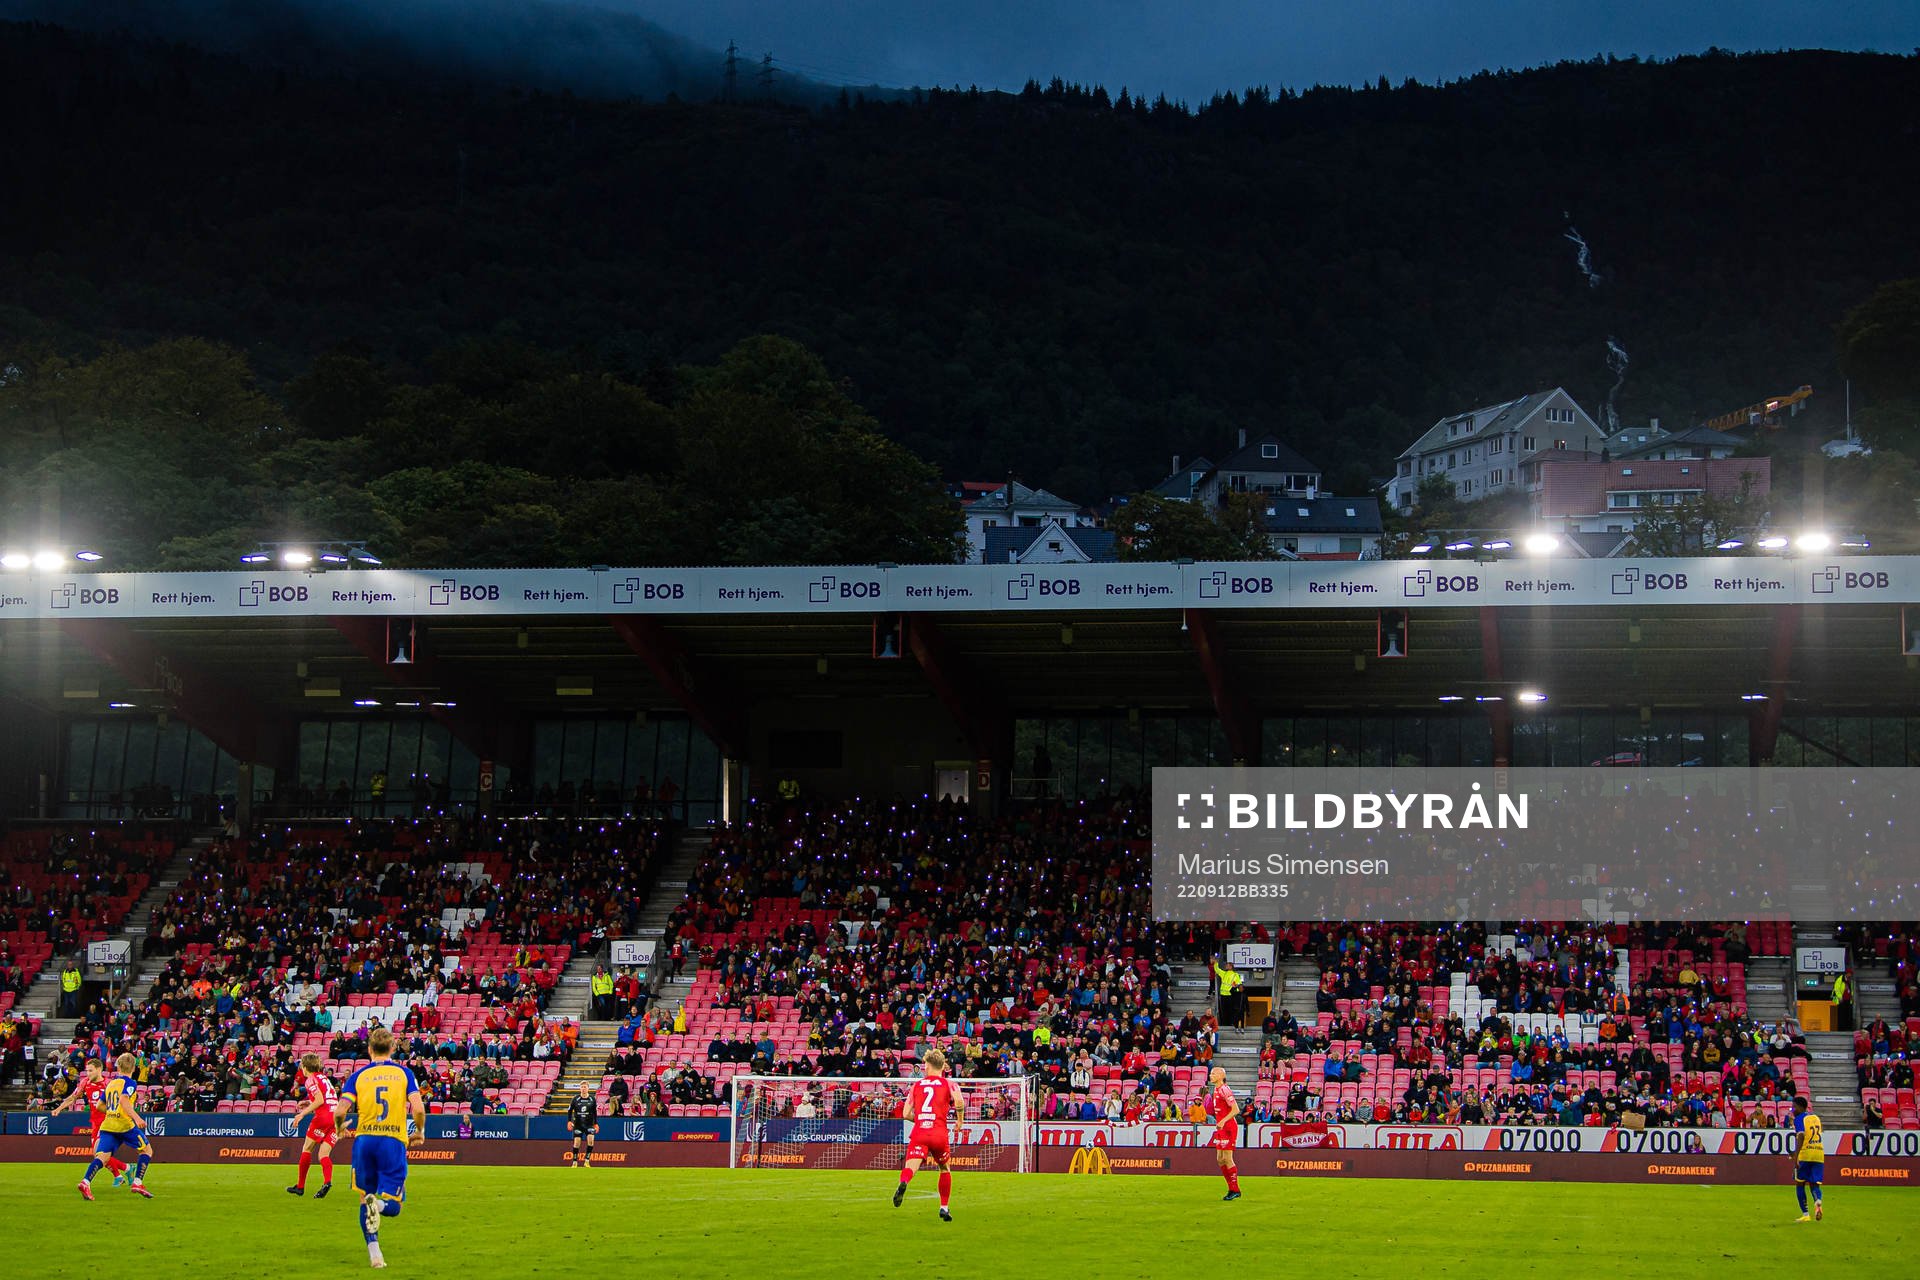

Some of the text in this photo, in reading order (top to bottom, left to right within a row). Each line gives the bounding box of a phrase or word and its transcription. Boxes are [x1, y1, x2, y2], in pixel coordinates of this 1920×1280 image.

[1232, 578, 1273, 593] BOB
[1437, 576, 1478, 592] BOB
[1506, 580, 1574, 593] Rett hjem.
[1645, 574, 1687, 589] BOB
[1715, 578, 1784, 592] Rett hjem.
[1846, 572, 1889, 588] BOB
[270, 587, 308, 601] BOB
[461, 585, 499, 600] BOB
[645, 584, 684, 599] BOB
[841, 582, 880, 597] BOB
[907, 586, 972, 599] Rett hjem.
[1040, 580, 1080, 595] BOB
[1106, 584, 1173, 597] Rett hjem.
[1310, 582, 1377, 595] Rett hjem.
[81, 589, 118, 604] BOB
[153, 592, 215, 605] Rett hjem.
[333, 591, 395, 604] Rett hjem.
[524, 589, 588, 602] Rett hjem.
[719, 588, 784, 601] Rett hjem.
[632, 954, 650, 962] BOB
[376, 1086, 389, 1122] 5
[921, 1086, 934, 1113] 2
[188, 1128, 254, 1136] LOS-GRUPPEN.NO
[442, 1130, 508, 1139] LOS-PPEN.NO
[792, 1134, 861, 1142] LOS-GRUPPEN.NO
[1809, 1125, 1822, 1144] 23
[1292, 1136, 1320, 1145] BRANN
[1500, 1129, 1582, 1152] 07000
[1735, 1132, 1797, 1154] 0700
[1852, 1132, 1919, 1156] 0700
[230, 1149, 281, 1158] PIZZABAKEREN
[1110, 1159, 1163, 1168] PIZZABAKEREN
[1287, 1161, 1342, 1170] PIZZABAKEREN
[1476, 1163, 1531, 1173] PIZZABAKEREN
[1659, 1166, 1715, 1175] PIZZABAKEREN
[1852, 1168, 1909, 1178] PIZZABAKEREN
